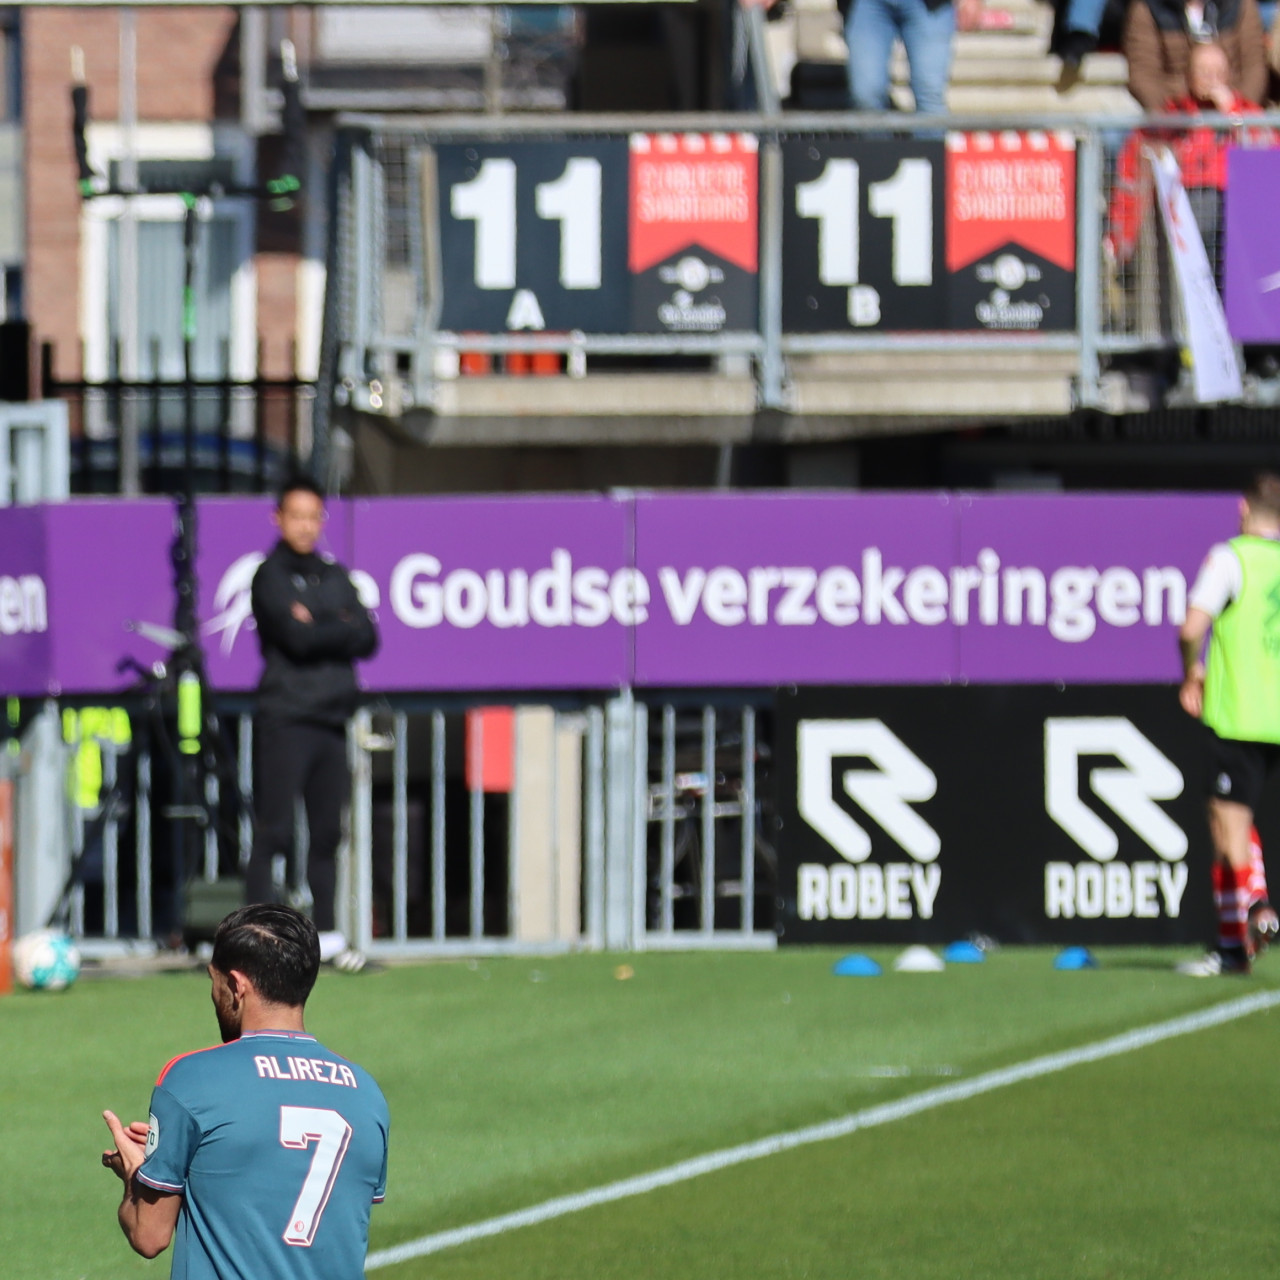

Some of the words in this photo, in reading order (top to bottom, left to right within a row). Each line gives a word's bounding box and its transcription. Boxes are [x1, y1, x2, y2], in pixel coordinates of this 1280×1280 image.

[451, 158, 601, 289] 11
[795, 158, 933, 286] 11
[505, 289, 545, 330] A
[847, 285, 881, 327] B
[389, 547, 651, 629] Goudse
[658, 546, 1188, 643] verzekeringen
[796, 862, 941, 921] ROBEY
[1044, 860, 1189, 919] ROBEY
[254, 1055, 358, 1089] ALIREZA
[280, 1105, 353, 1247] 7
